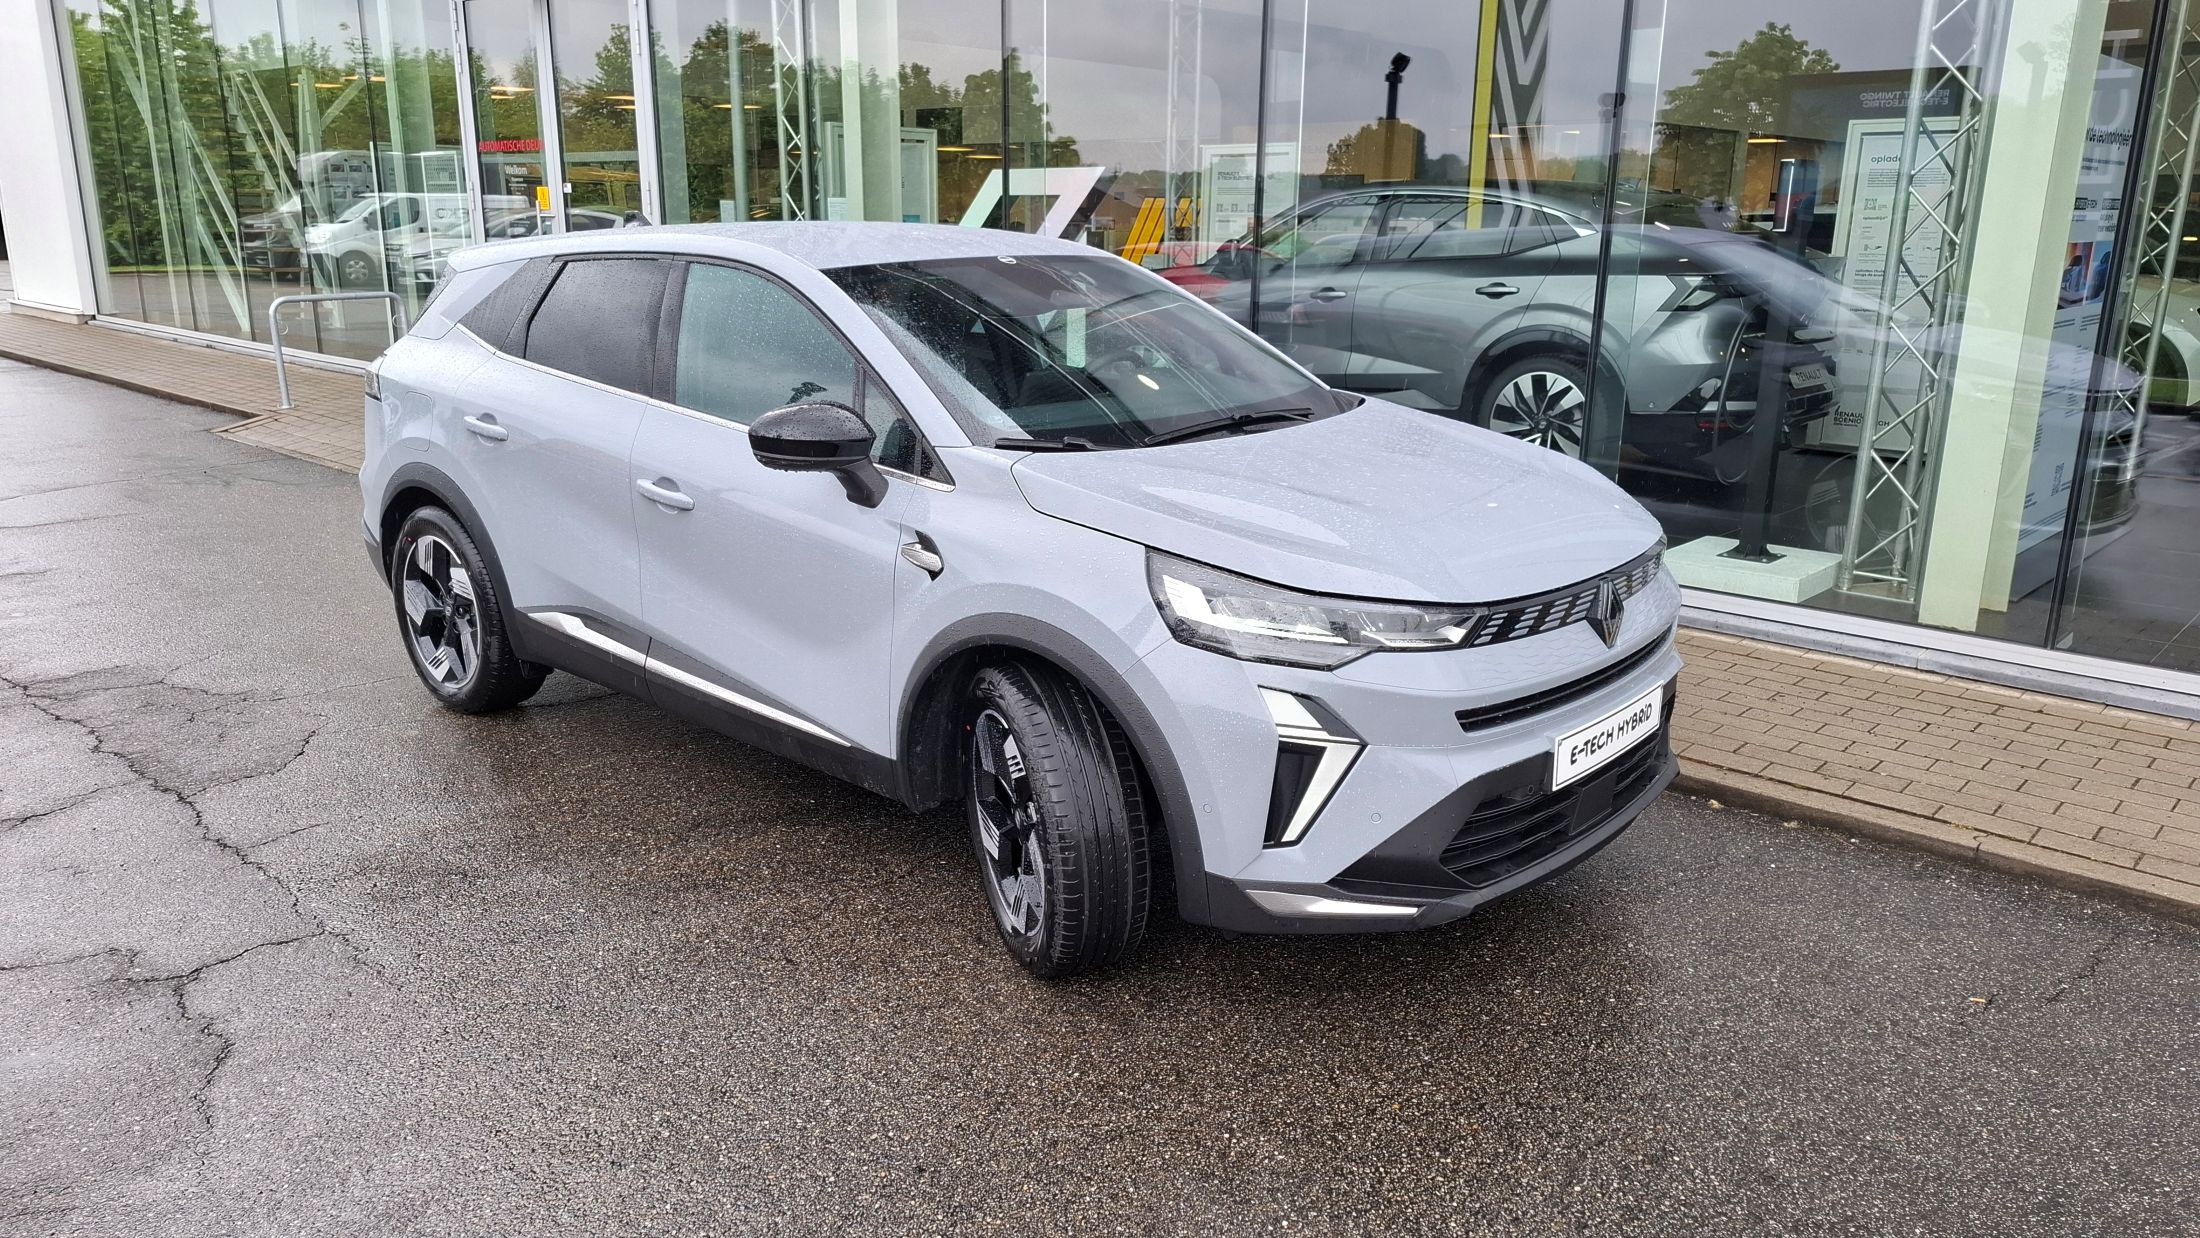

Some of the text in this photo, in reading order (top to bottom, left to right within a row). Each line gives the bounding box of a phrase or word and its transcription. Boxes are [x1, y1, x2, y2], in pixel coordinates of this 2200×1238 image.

[479, 139, 526, 153] AUTOMATISCHE
[505, 164, 528, 175] Welkom
[1795, 368, 1823, 382] RENAULT
[1570, 726, 1614, 766] E-TECH
